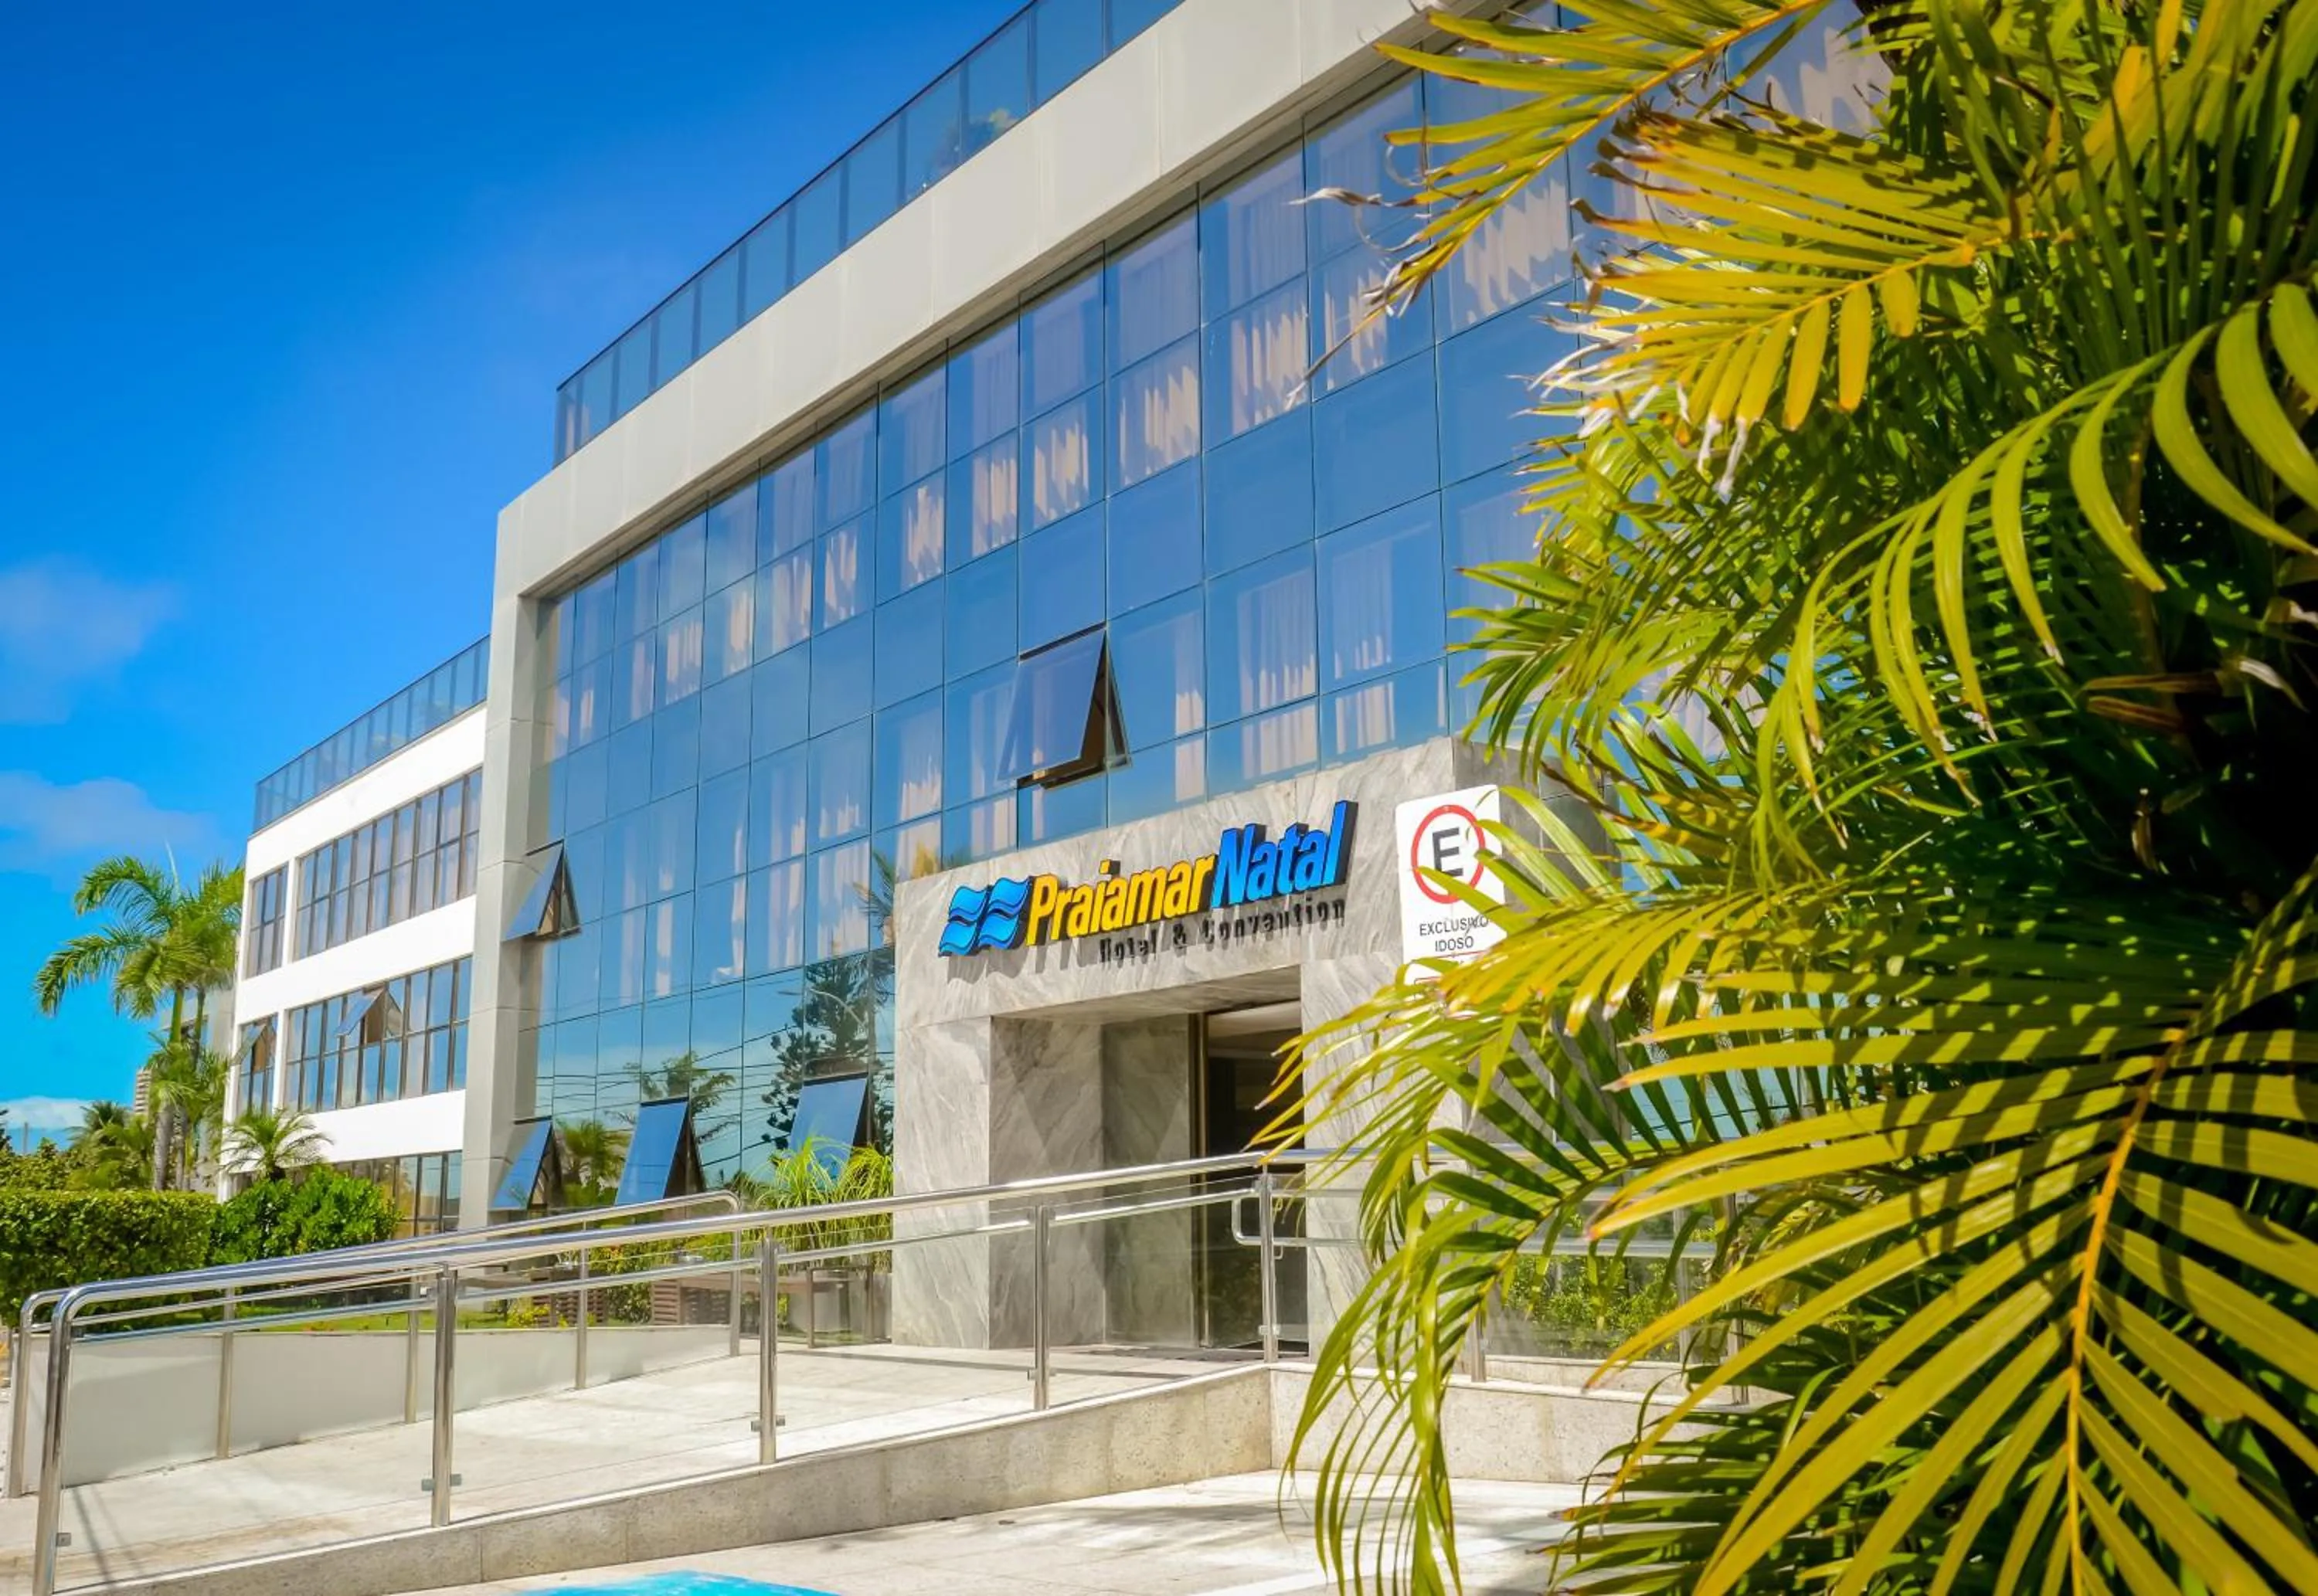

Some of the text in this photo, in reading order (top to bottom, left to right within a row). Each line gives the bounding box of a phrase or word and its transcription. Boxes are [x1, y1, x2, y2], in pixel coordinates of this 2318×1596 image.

[1433, 827, 1463, 877] E
[1100, 896, 1345, 963] Hotel & Convention
[1419, 915, 1490, 936] EXCLUSIVO
[1435, 936, 1474, 952] IDOSO
